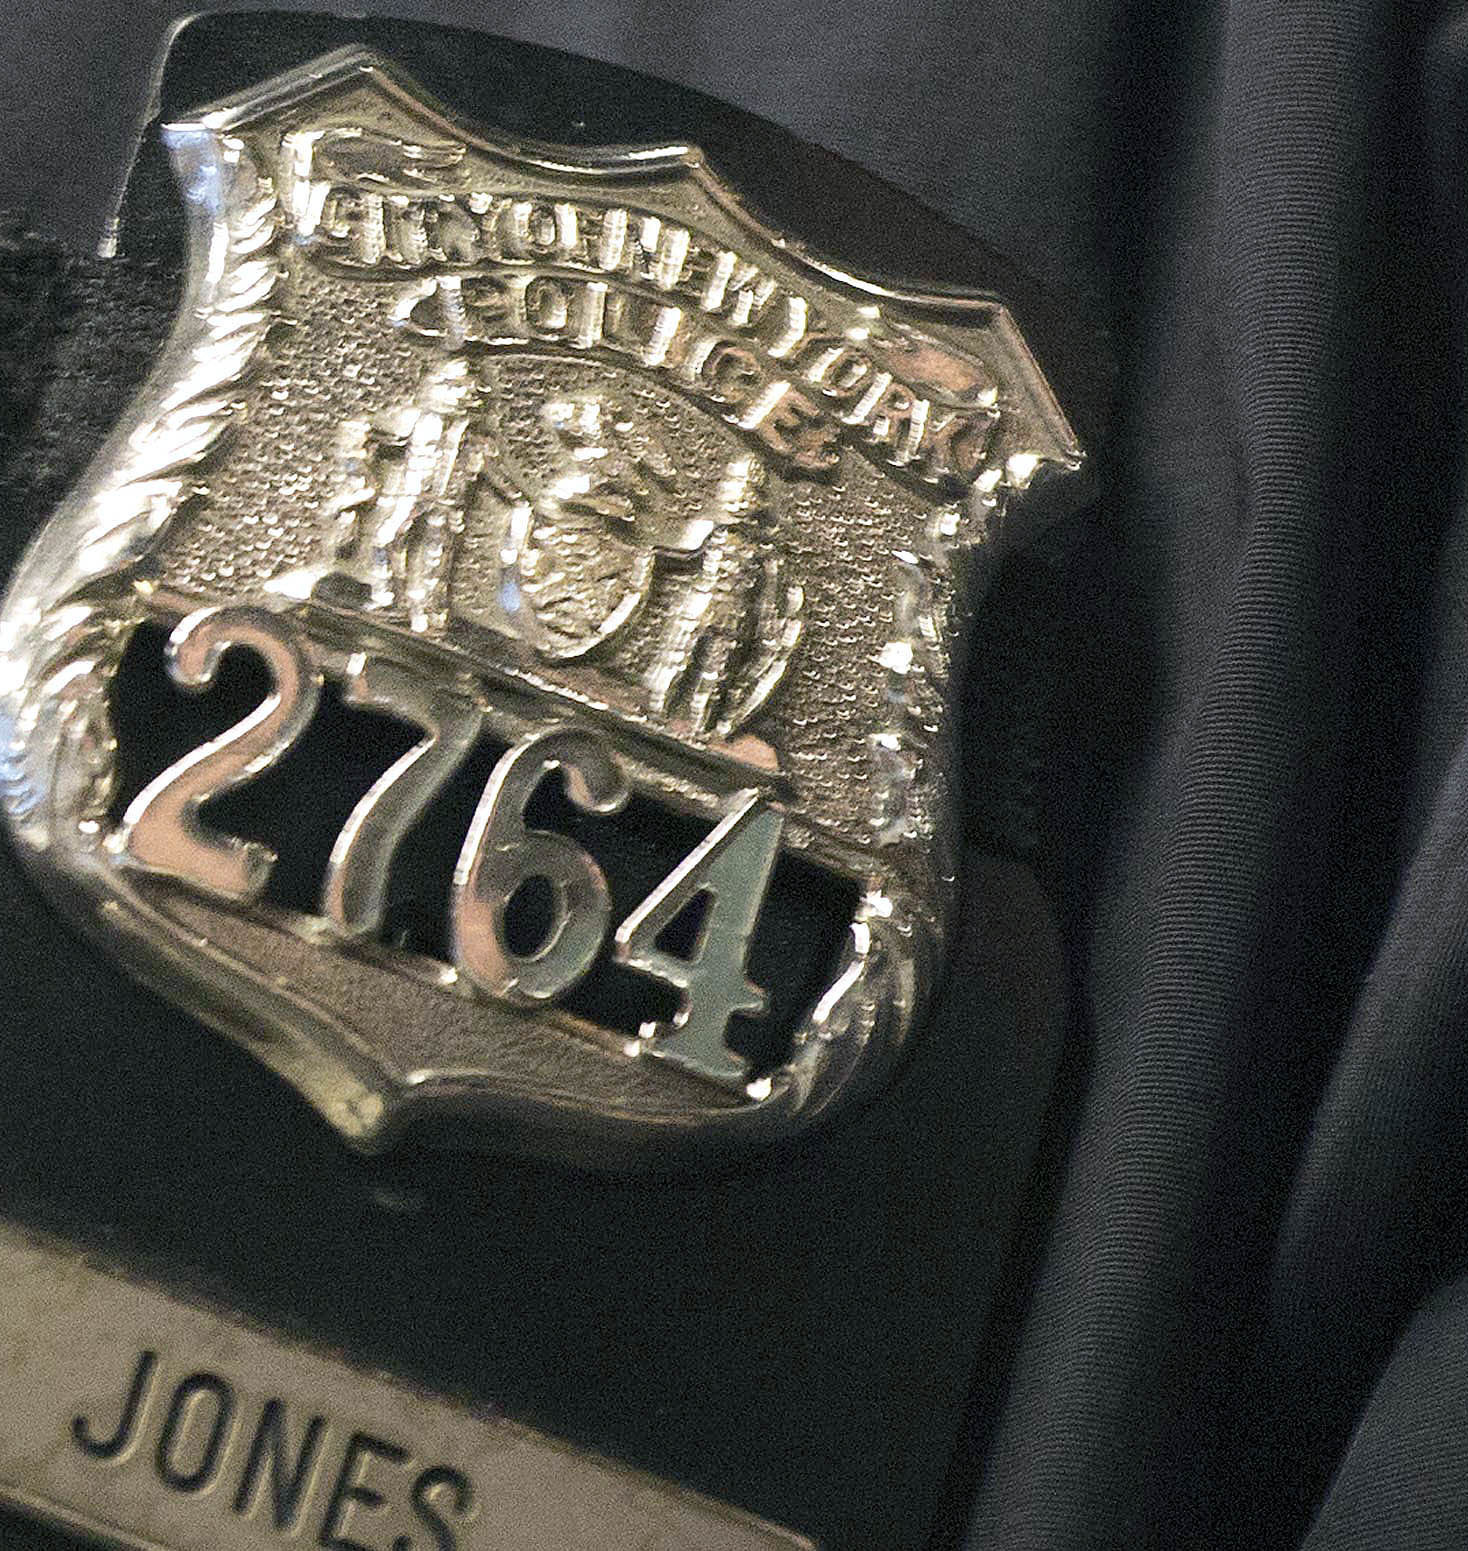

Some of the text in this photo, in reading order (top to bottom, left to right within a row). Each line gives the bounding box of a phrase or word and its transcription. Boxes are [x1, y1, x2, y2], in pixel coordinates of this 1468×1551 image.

[319, 188, 496, 270] CITY
[596, 206, 780, 332] NEW
[768, 294, 986, 484] YORK
[454, 272, 829, 466] POLICE
[110, 604, 786, 1078] 2764
[72, 1350, 474, 1551] JONES
